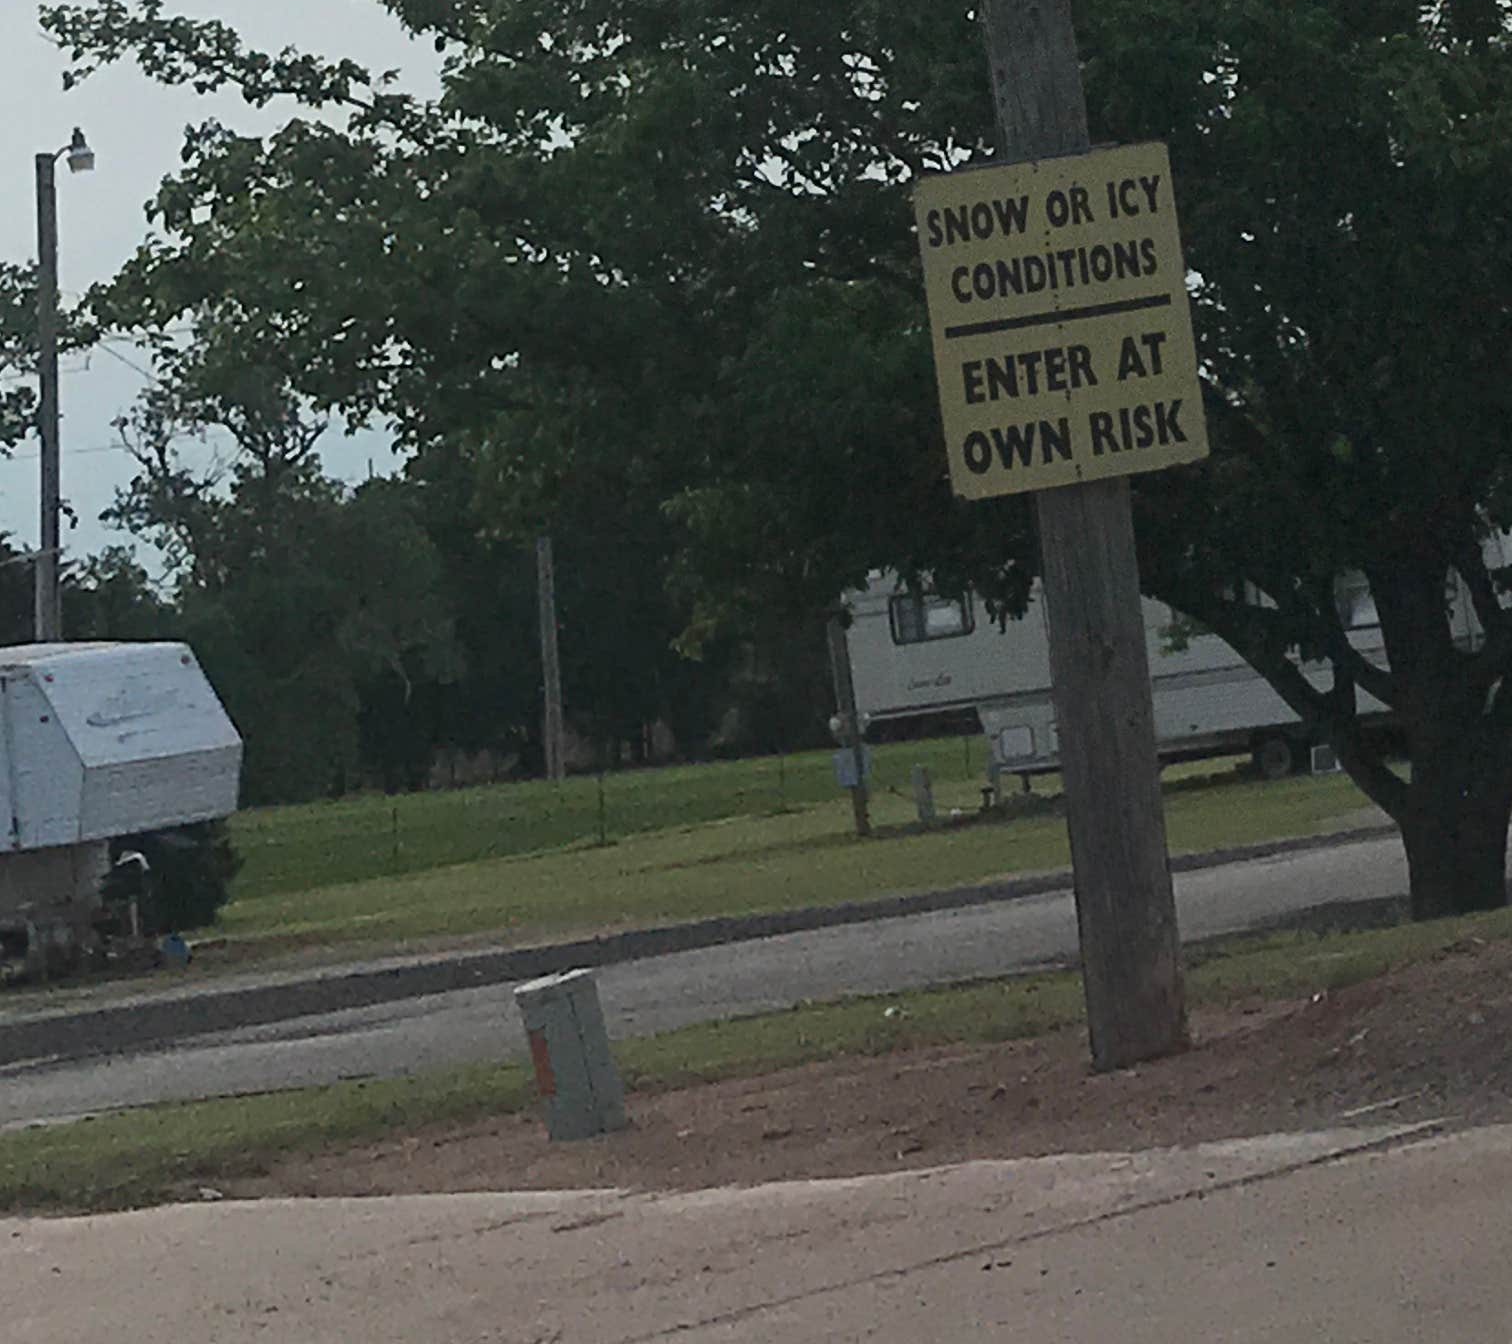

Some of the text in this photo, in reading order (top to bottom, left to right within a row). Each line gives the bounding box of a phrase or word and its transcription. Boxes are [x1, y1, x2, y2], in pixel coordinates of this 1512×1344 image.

[927, 175, 1160, 247] SNOW OR ICY
[951, 238, 1157, 303] CONDITIONS
[962, 332, 1166, 404] ENTER AT
[963, 399, 1188, 475] OWN RISK
